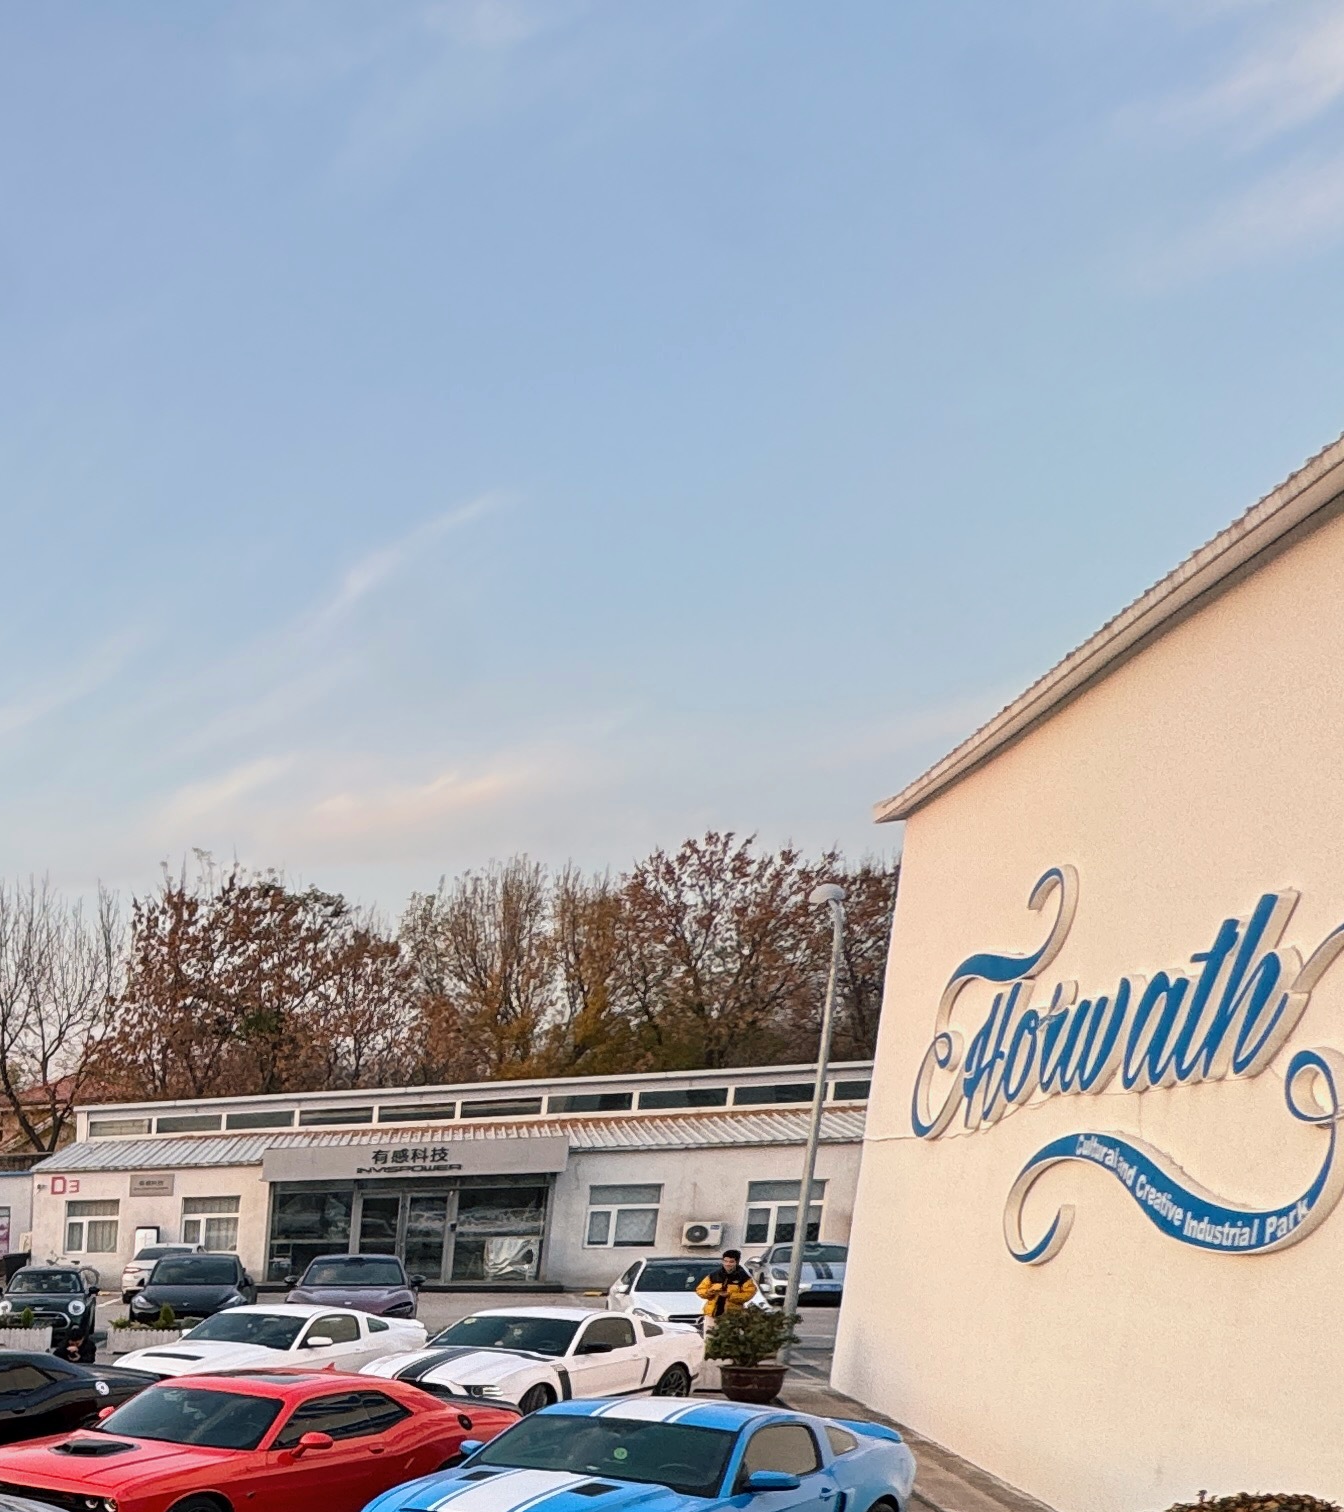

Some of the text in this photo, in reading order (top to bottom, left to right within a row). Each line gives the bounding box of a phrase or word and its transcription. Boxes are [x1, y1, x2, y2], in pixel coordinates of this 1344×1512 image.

[372, 1147, 449, 1164] 有感科技
[1075, 1134, 1120, 1169] Cultural
[1135, 1175, 1184, 1226] Creative
[1183, 1211, 1259, 1247] Industrial
[1264, 1198, 1312, 1244] Park
